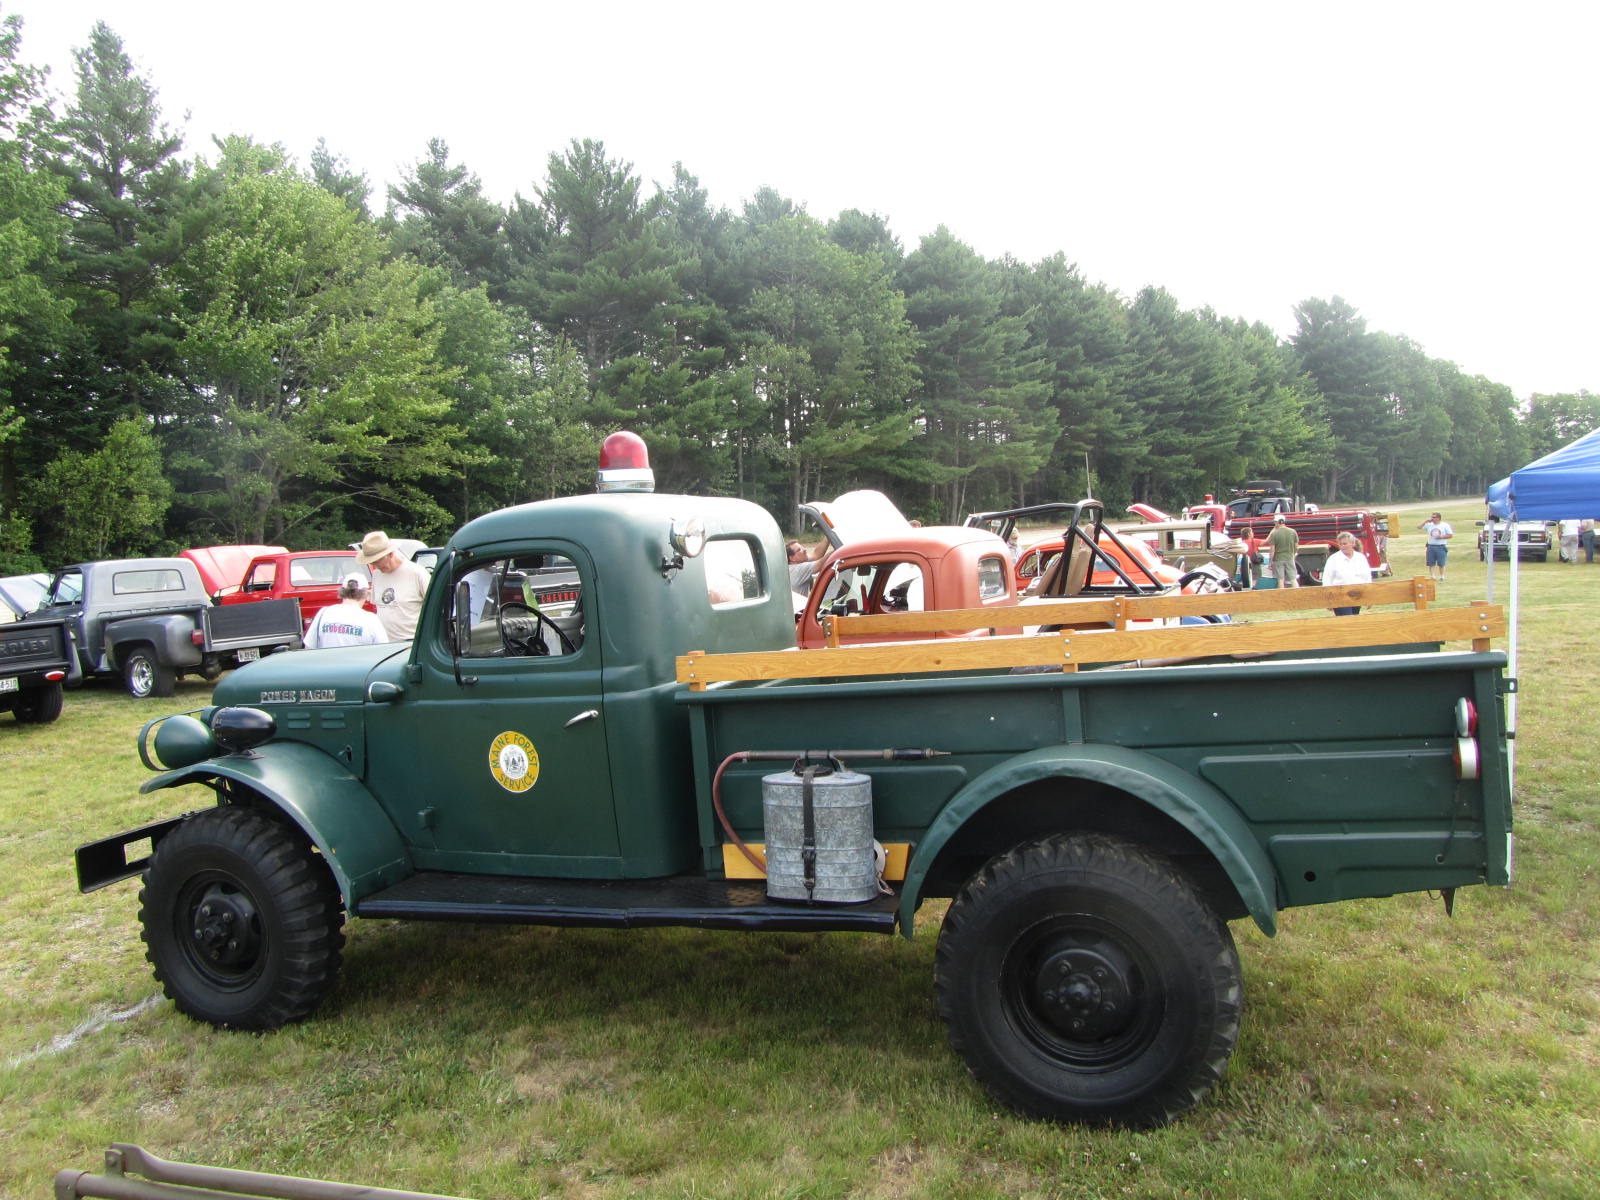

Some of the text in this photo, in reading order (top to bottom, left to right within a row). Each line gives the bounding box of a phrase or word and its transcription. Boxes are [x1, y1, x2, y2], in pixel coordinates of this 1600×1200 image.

[321, 623, 363, 636] STUDEBAKER
[260, 689, 336, 703] POWER WAGON
[491, 733, 538, 769] MAINE FOREST
[498, 771, 536, 789] SERVICE
